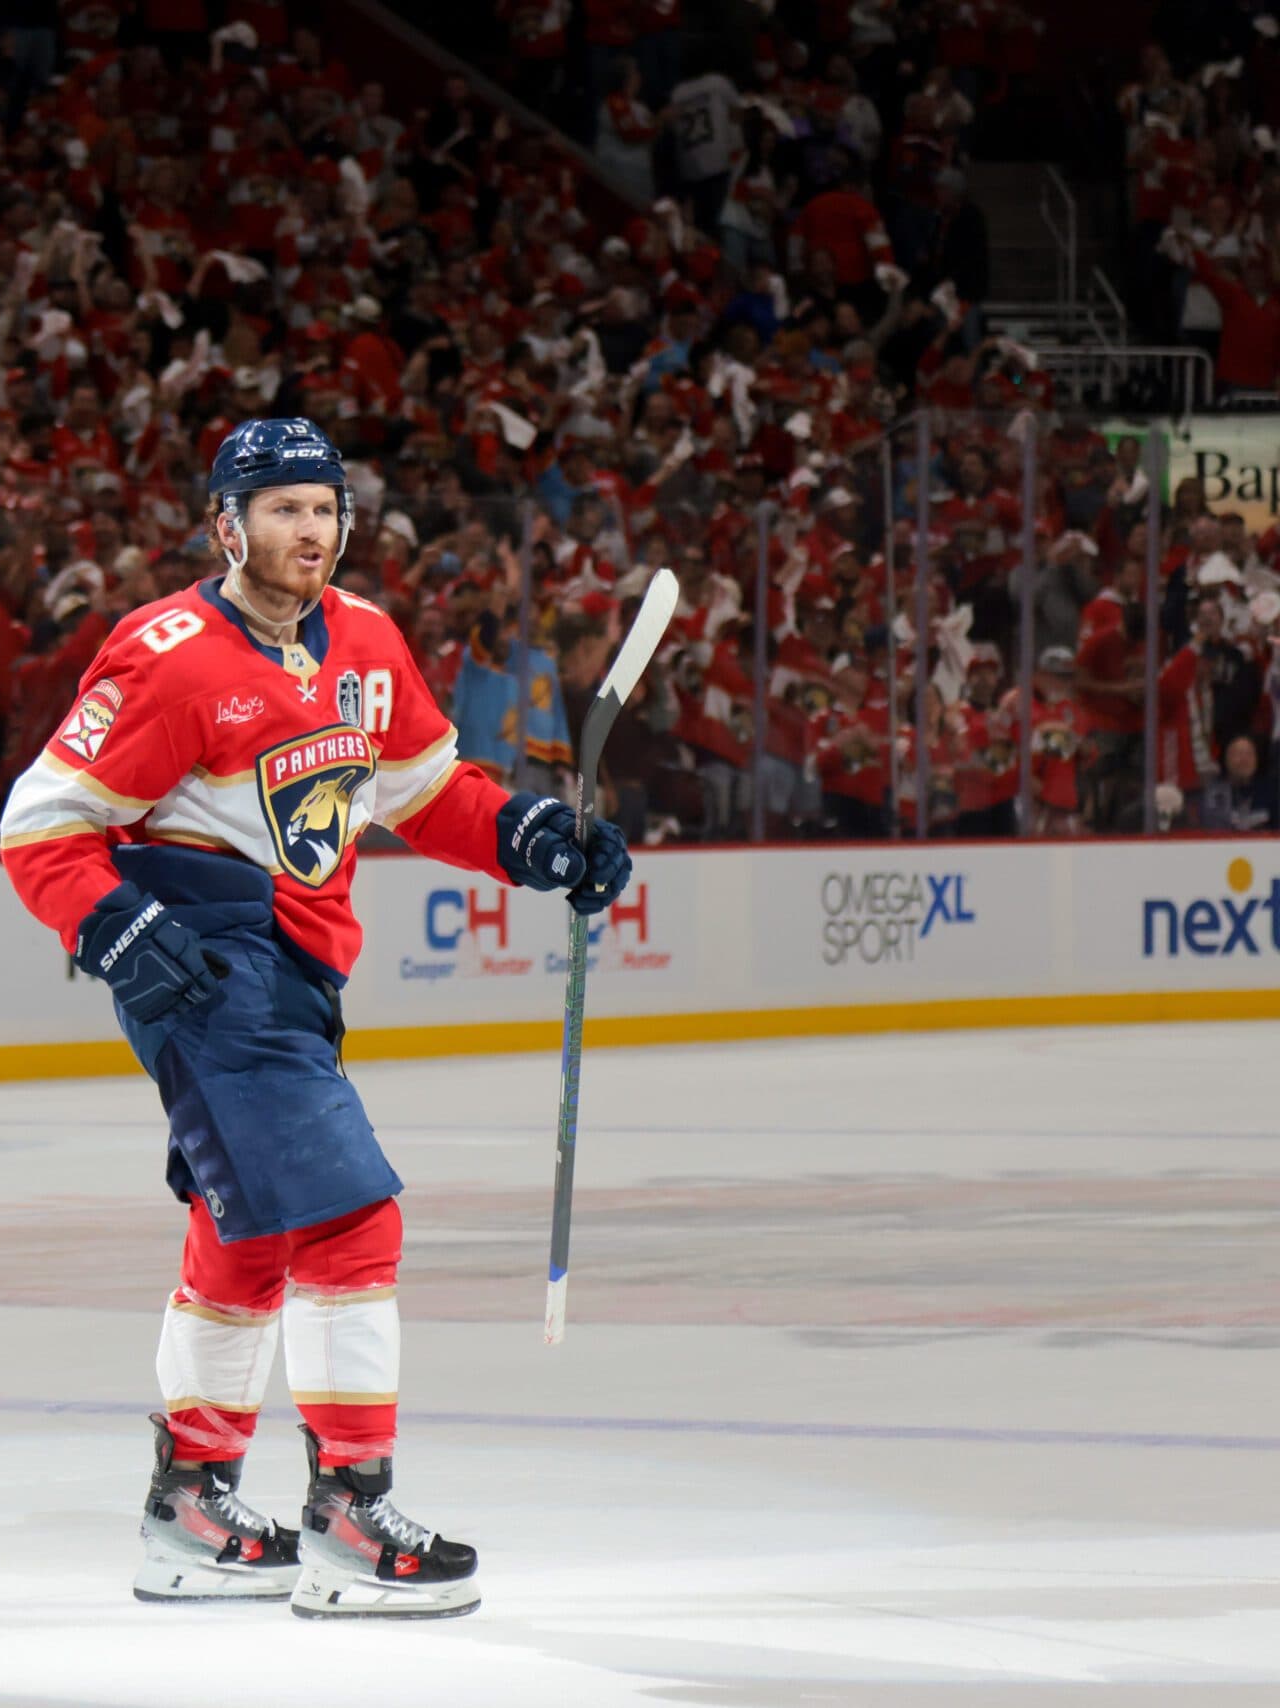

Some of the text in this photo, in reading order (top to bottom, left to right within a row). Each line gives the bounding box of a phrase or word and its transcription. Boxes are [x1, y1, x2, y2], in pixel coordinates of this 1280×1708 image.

[283, 449, 324, 458] CCM
[364, 668, 393, 732] A
[274, 736, 366, 780] PANTHERS
[425, 886, 509, 950] CH
[822, 919, 918, 966] SPORT
